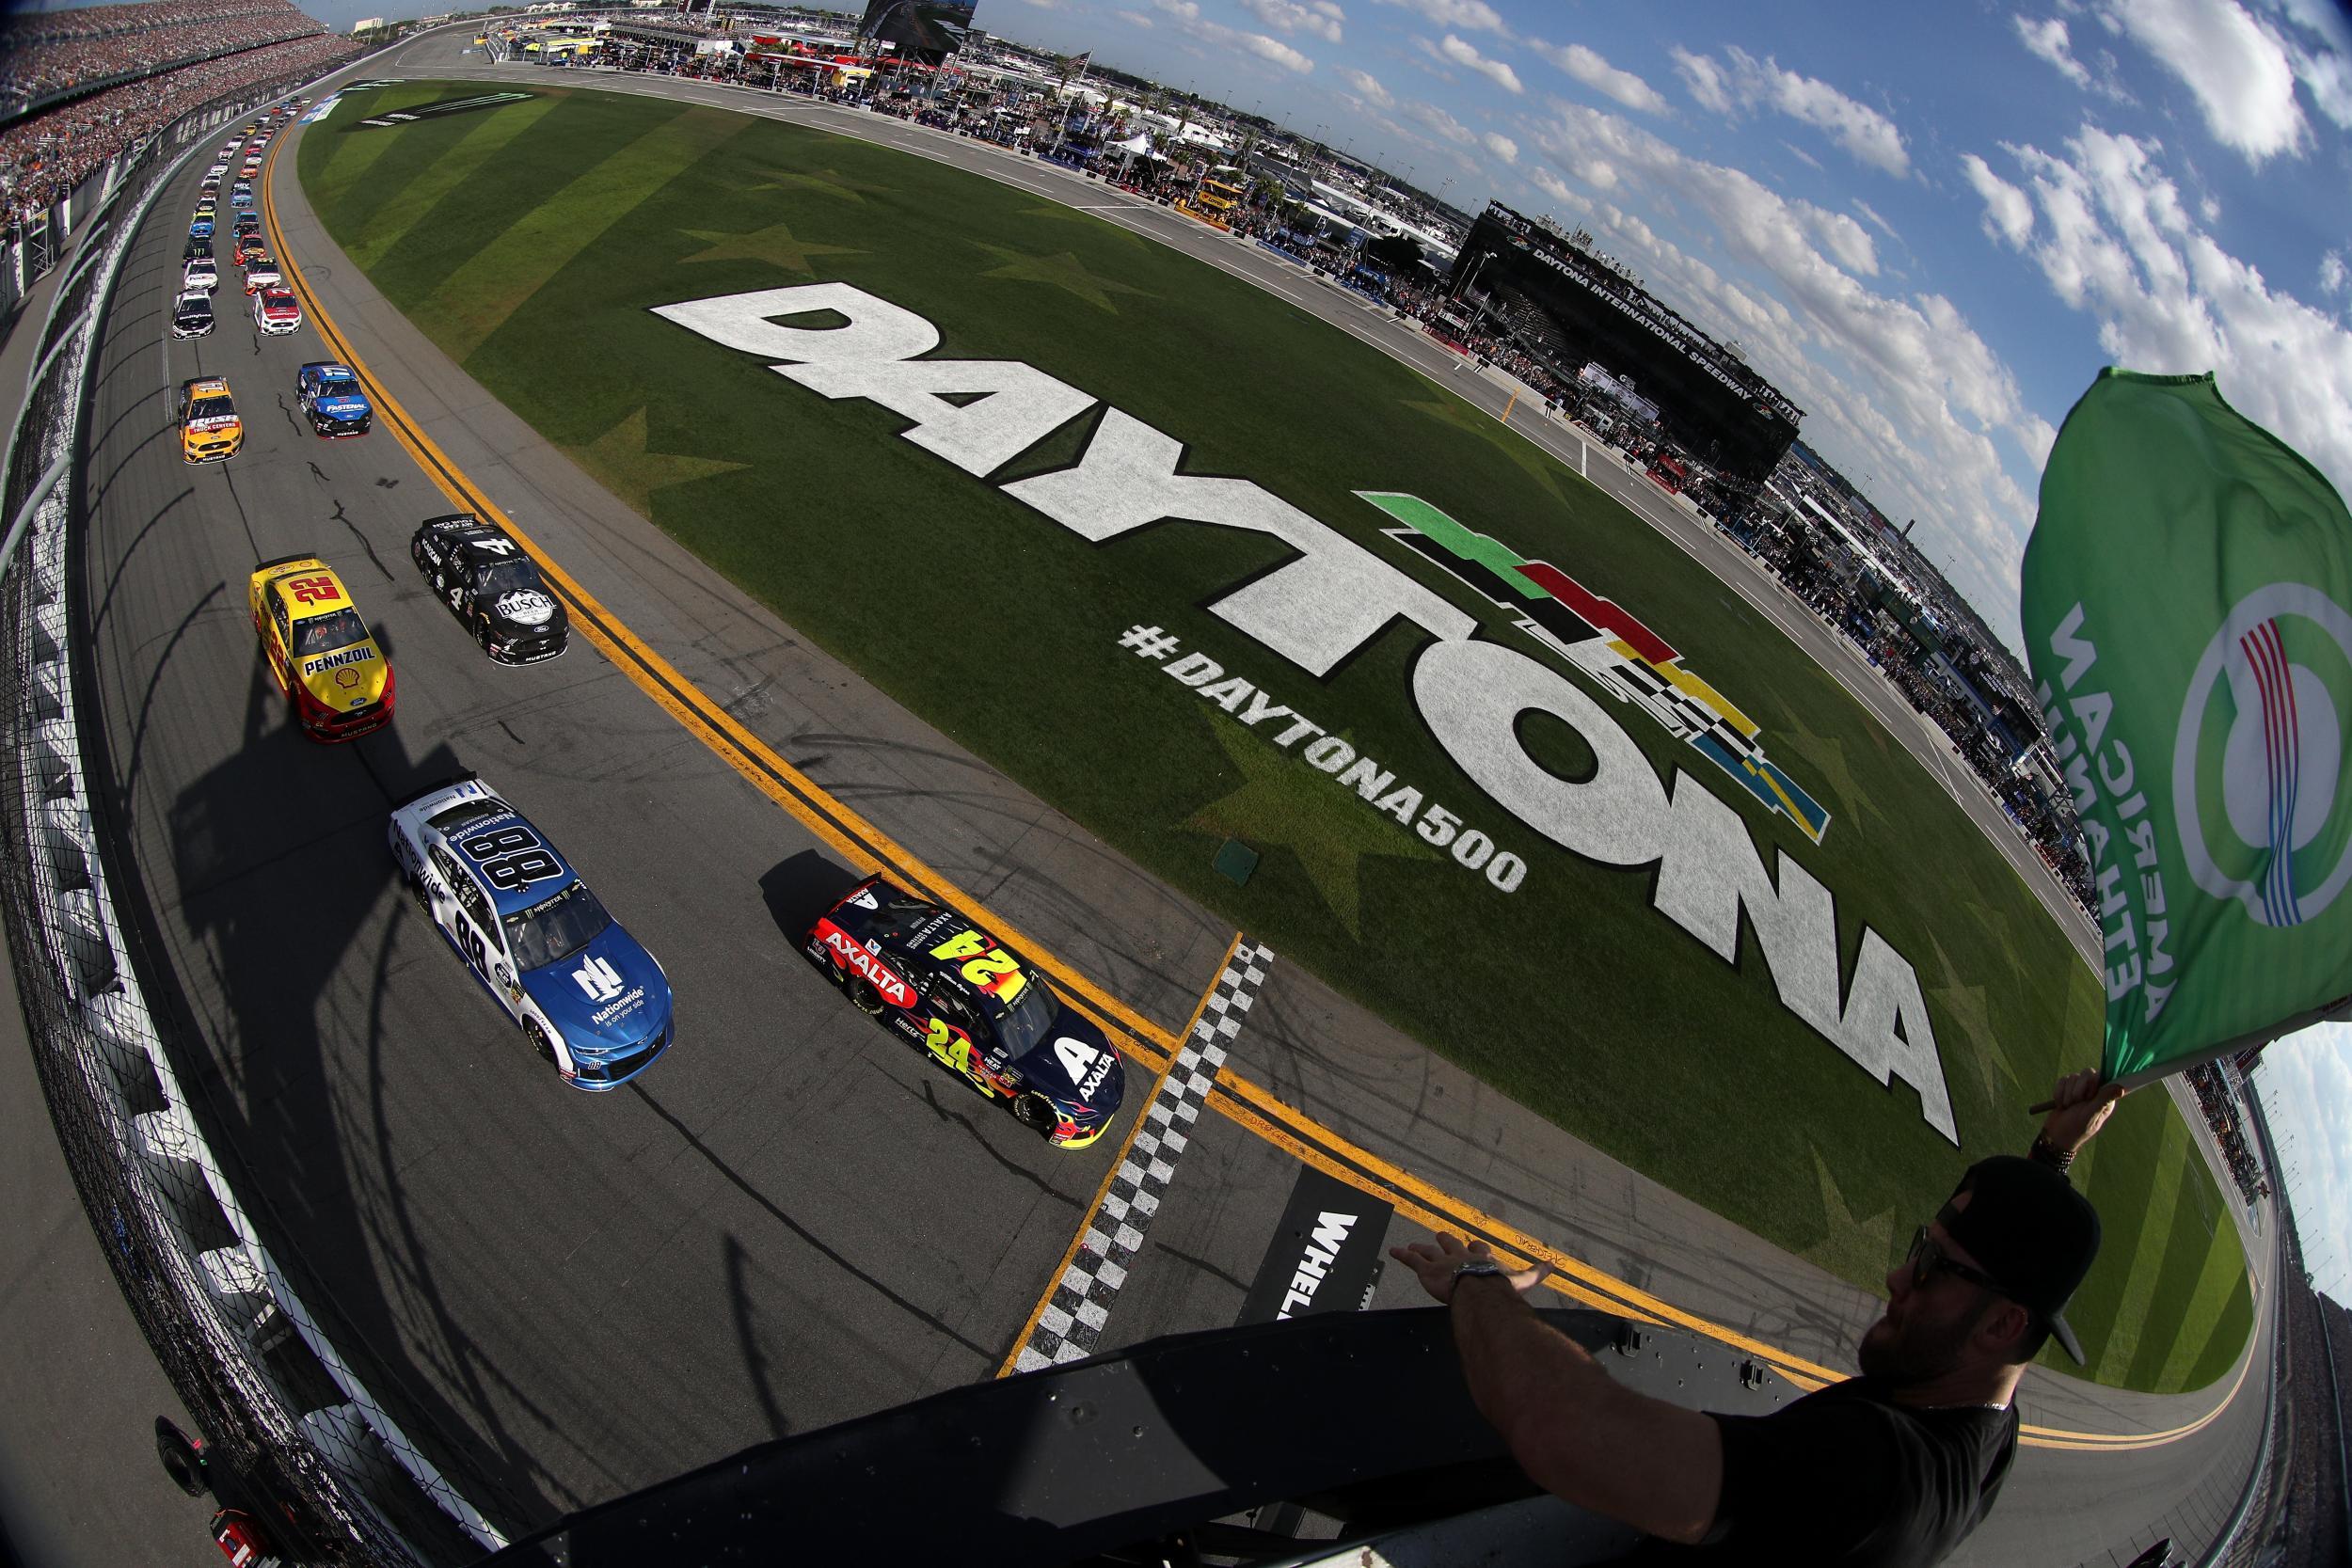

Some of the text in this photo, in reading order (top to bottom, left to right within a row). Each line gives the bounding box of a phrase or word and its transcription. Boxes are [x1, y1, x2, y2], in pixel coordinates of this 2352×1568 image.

[1533, 248, 1753, 400] DAYTONA INTERNATIONAL SPEEDWAY
[326, 404, 368, 413] FASTENAL
[193, 421, 236, 434] TRUCK CENTERS
[471, 538, 516, 556] 4
[288, 576, 341, 603] 22
[450, 586, 464, 611] 4
[497, 595, 554, 617] BUSCH
[304, 646, 375, 677] PENNZOIL
[525, 650, 557, 662] MUSTANG
[649, 282, 1961, 1148] DAYTONA
[341, 722, 377, 738] MUSTANG
[1117, 624, 1528, 894] #DAYTONA500
[420, 794, 456, 812] Nationwide
[449, 812, 516, 843] Nationwide
[393, 818, 446, 904] Nationwide
[459, 825, 564, 890] 88
[533, 895, 563, 912] MONSTER
[921, 911, 953, 936] AXALTA
[455, 910, 491, 984] 88
[825, 932, 906, 1003] AXALTA
[929, 929, 1027, 1005] 24
[591, 987, 644, 1025] Nationwide
[605, 999, 644, 1027] is on your side
[895, 1017, 919, 1037] Hertz
[926, 1018, 971, 1074] 24
[588, 1061, 602, 1070] 88
[983, 1056, 1002, 1071] HEAT
[1078, 1052, 1116, 1102] AXALTA
[1276, 1211, 1359, 1320] WHEL
